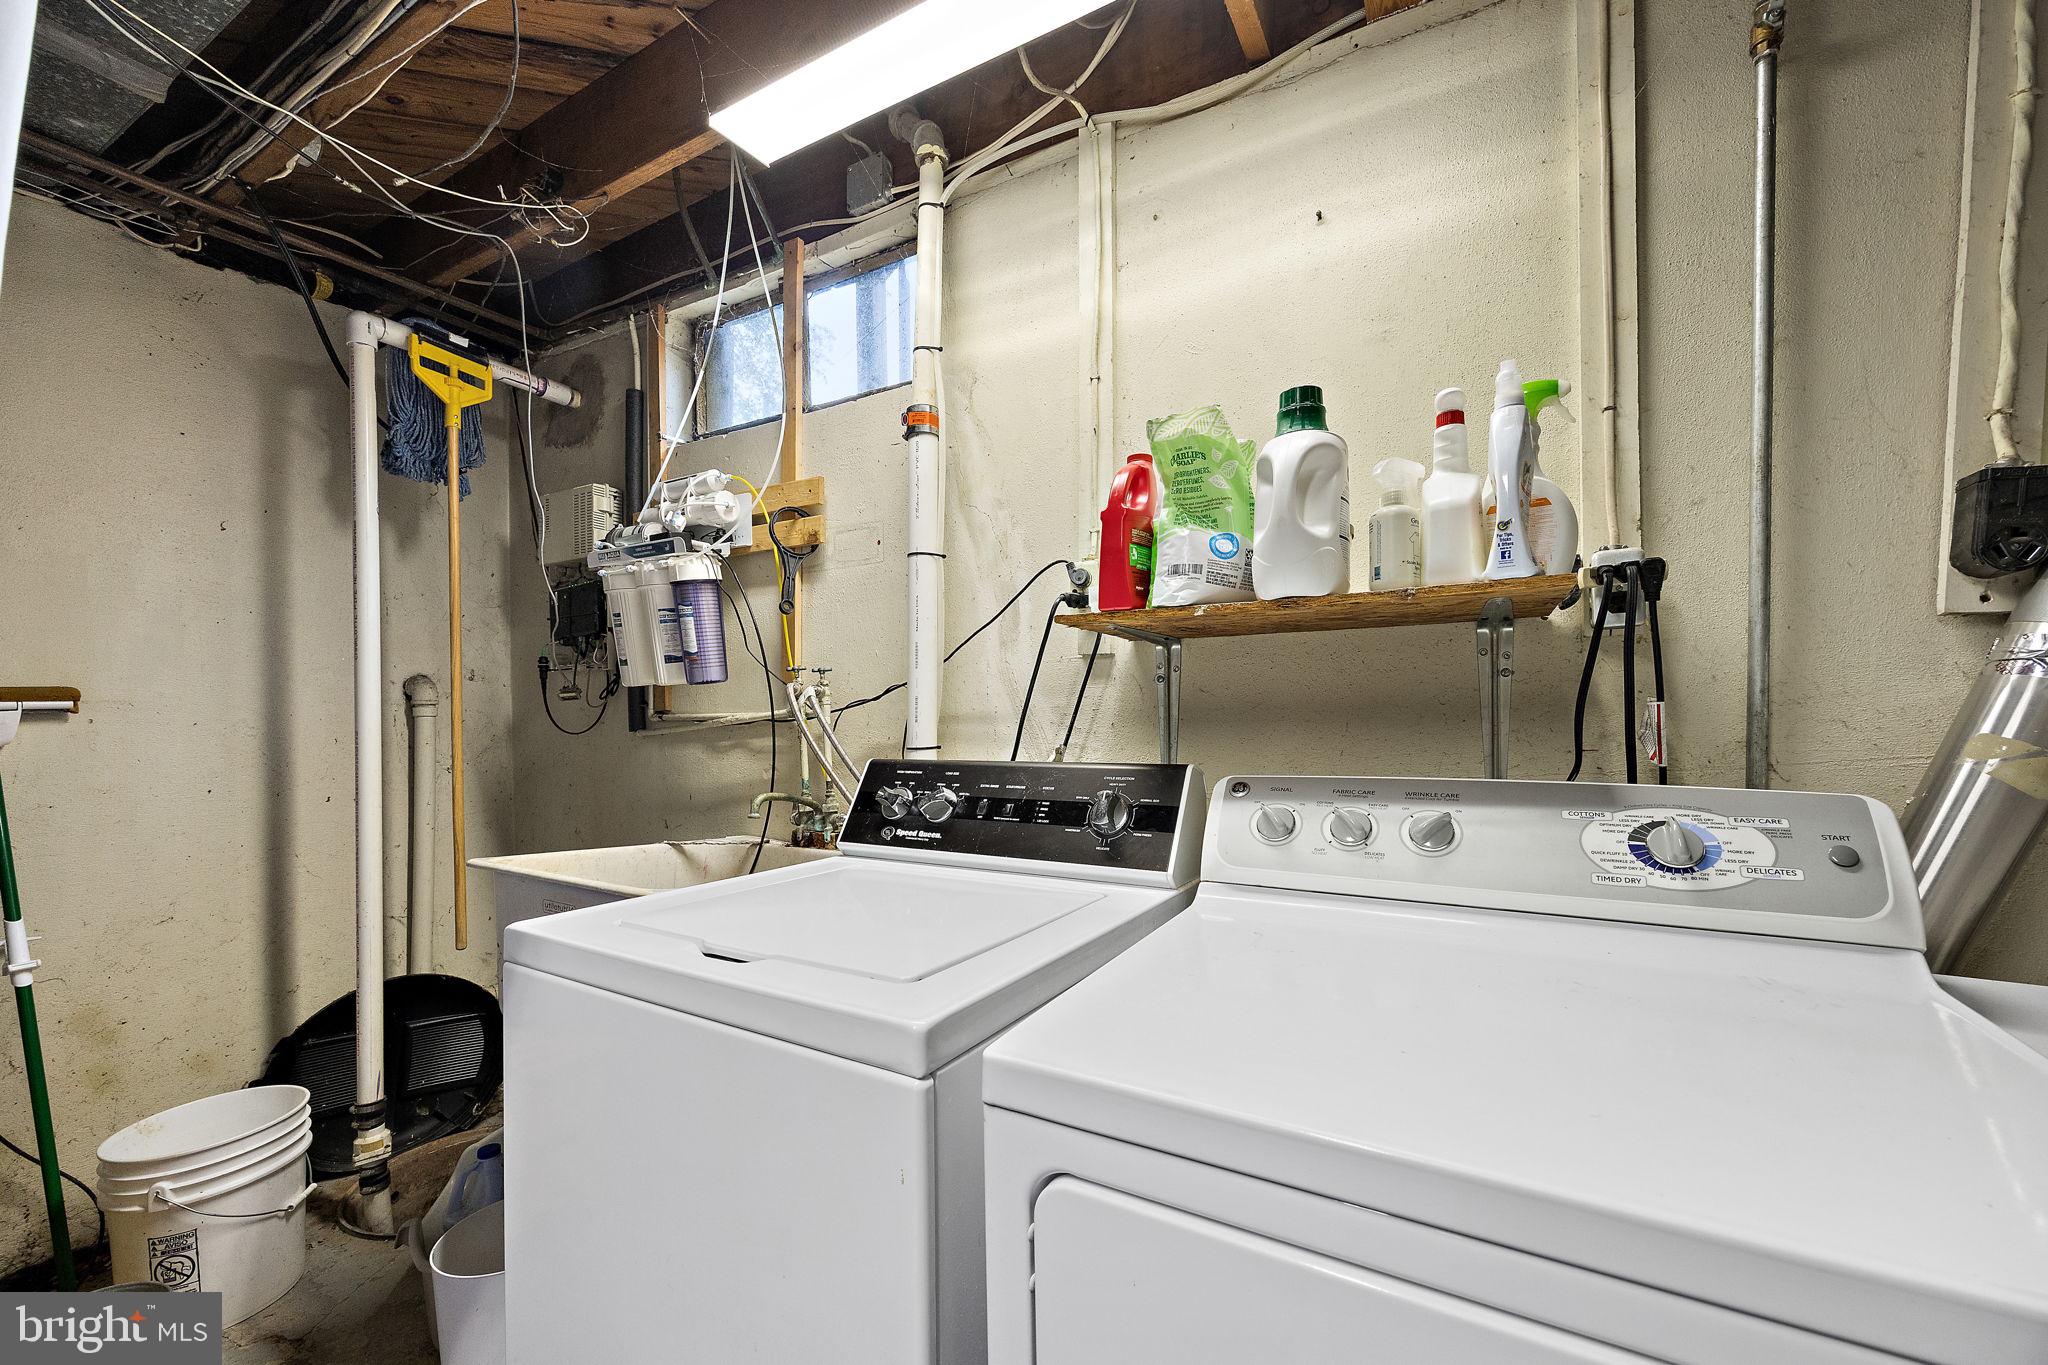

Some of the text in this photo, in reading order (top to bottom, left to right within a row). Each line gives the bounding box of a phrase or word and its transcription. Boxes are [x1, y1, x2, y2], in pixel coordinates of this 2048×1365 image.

[896, 828, 918, 837] Speed
[1746, 868, 1797, 876] DELICATES
[1596, 875, 1622, 883] TIMED
[158, 1232, 194, 1245] WARNING
[165, 1240, 188, 1249] AVISO
